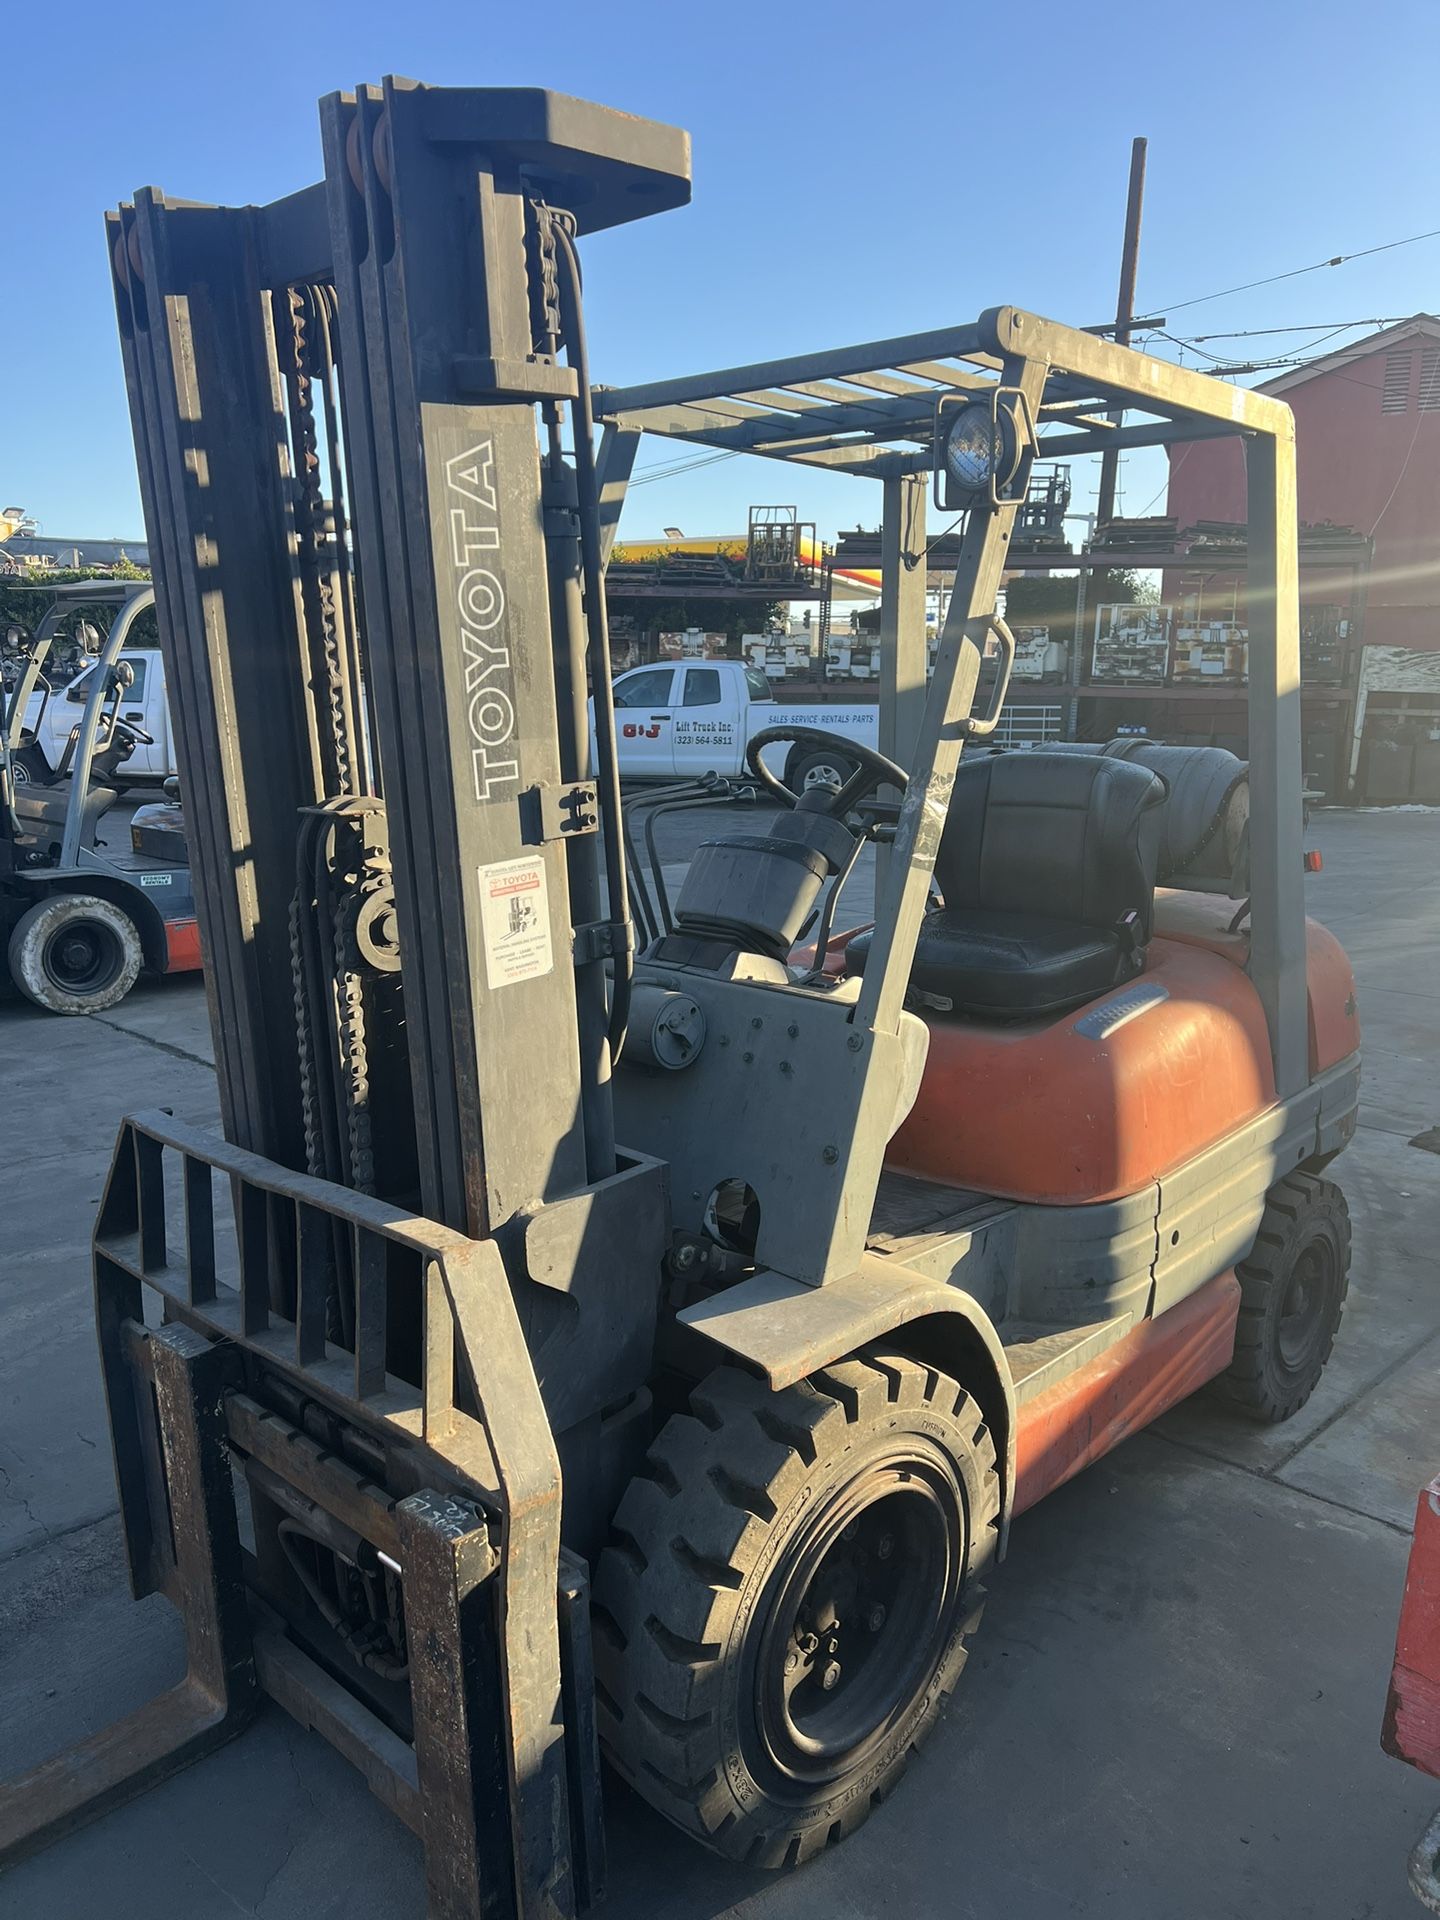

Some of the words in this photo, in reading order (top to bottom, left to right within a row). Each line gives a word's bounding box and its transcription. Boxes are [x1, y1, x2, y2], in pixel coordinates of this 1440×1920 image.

[446, 439, 518, 800] TOYOTA
[768, 715, 789, 724] SALES
[790, 714, 818, 724] SERVICE
[821, 714, 850, 724] RENTALS
[852, 714, 874, 724] PARTS
[676, 721, 690, 732] Lift
[692, 721, 717, 732] Truck
[718, 721, 734, 733] Inc.
[673, 736, 694, 745] (323)
[695, 736, 733, 745] 564-5811
[502, 871, 538, 885] TOYOTA
